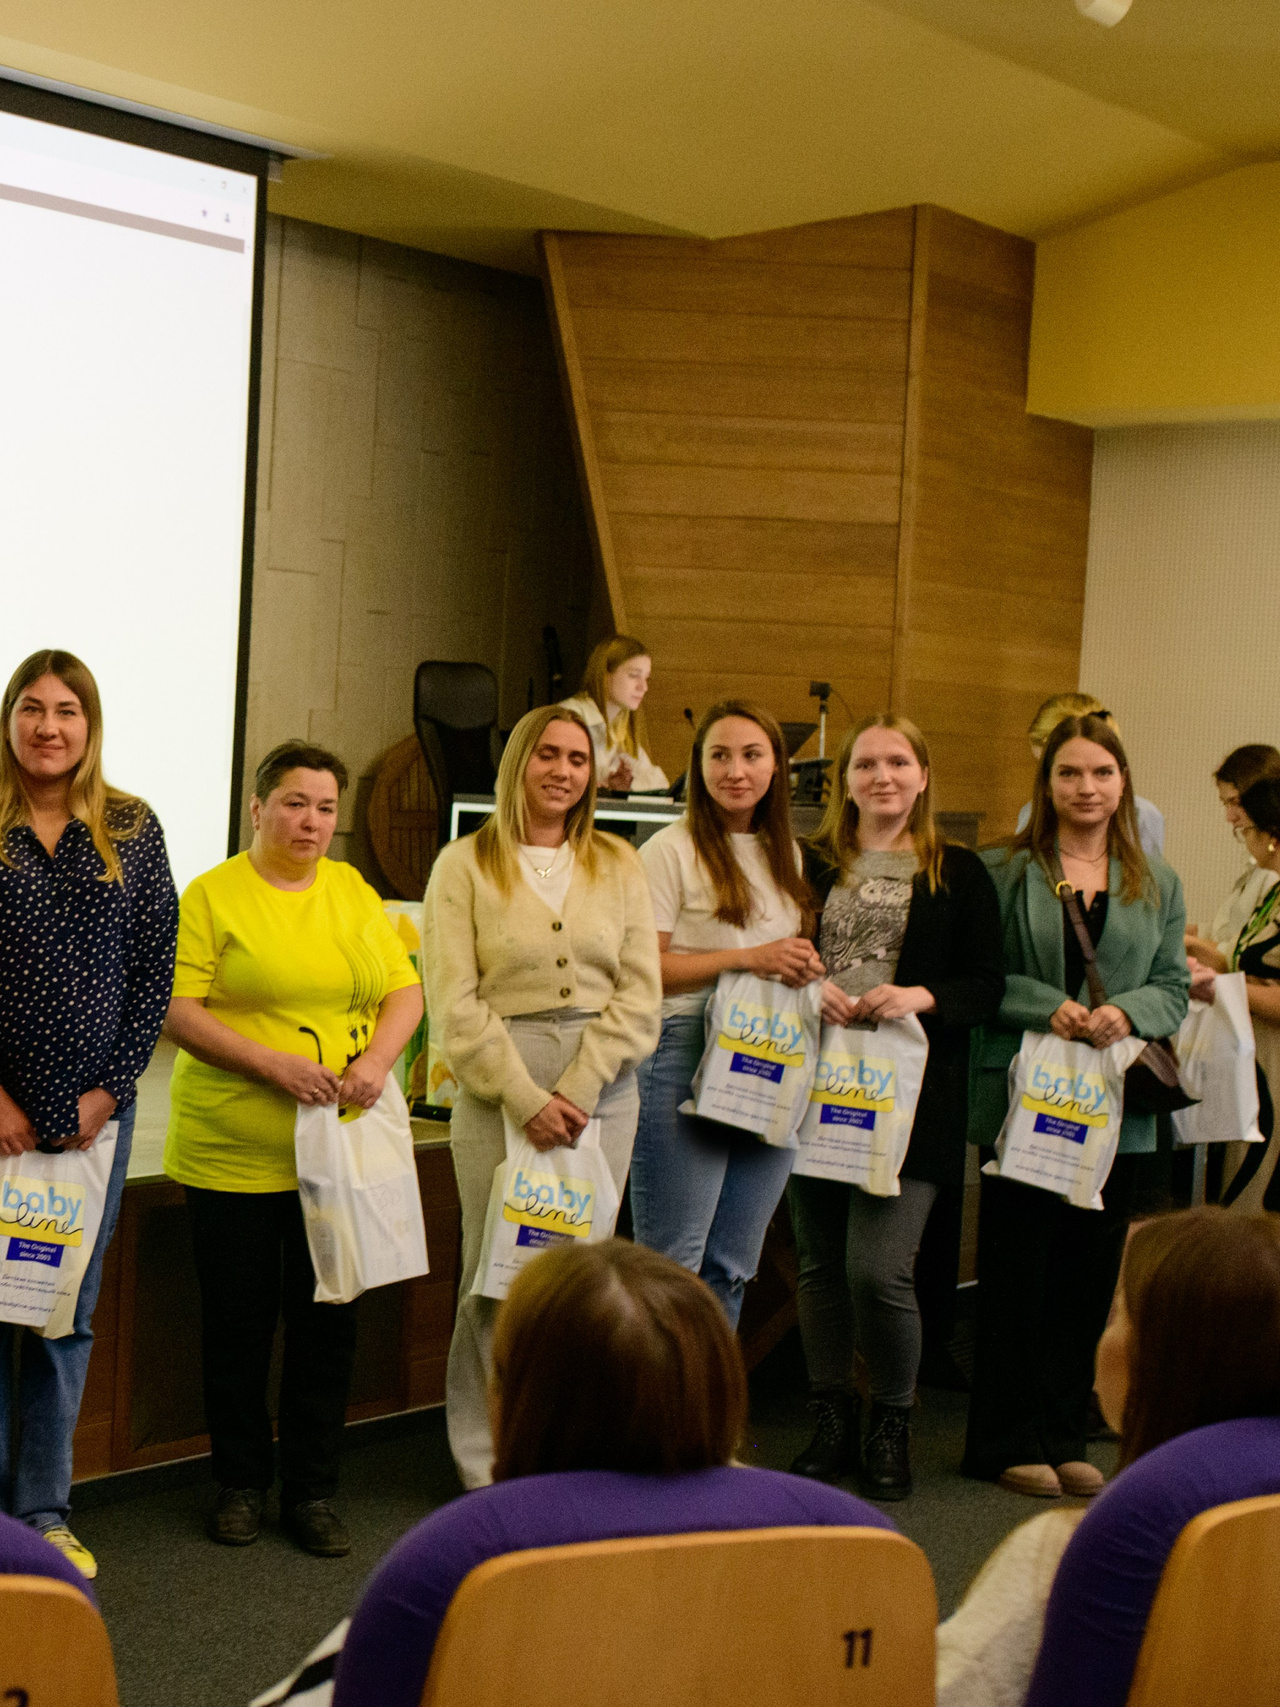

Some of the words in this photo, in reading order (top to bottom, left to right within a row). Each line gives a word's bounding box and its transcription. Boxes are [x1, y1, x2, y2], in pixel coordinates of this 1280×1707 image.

[729, 1004, 803, 1049] baby
[1032, 1064, 1106, 1109] baby
[2, 1181, 82, 1227] baby
[513, 1171, 591, 1218] baby
[843, 1628, 873, 1668] 11
